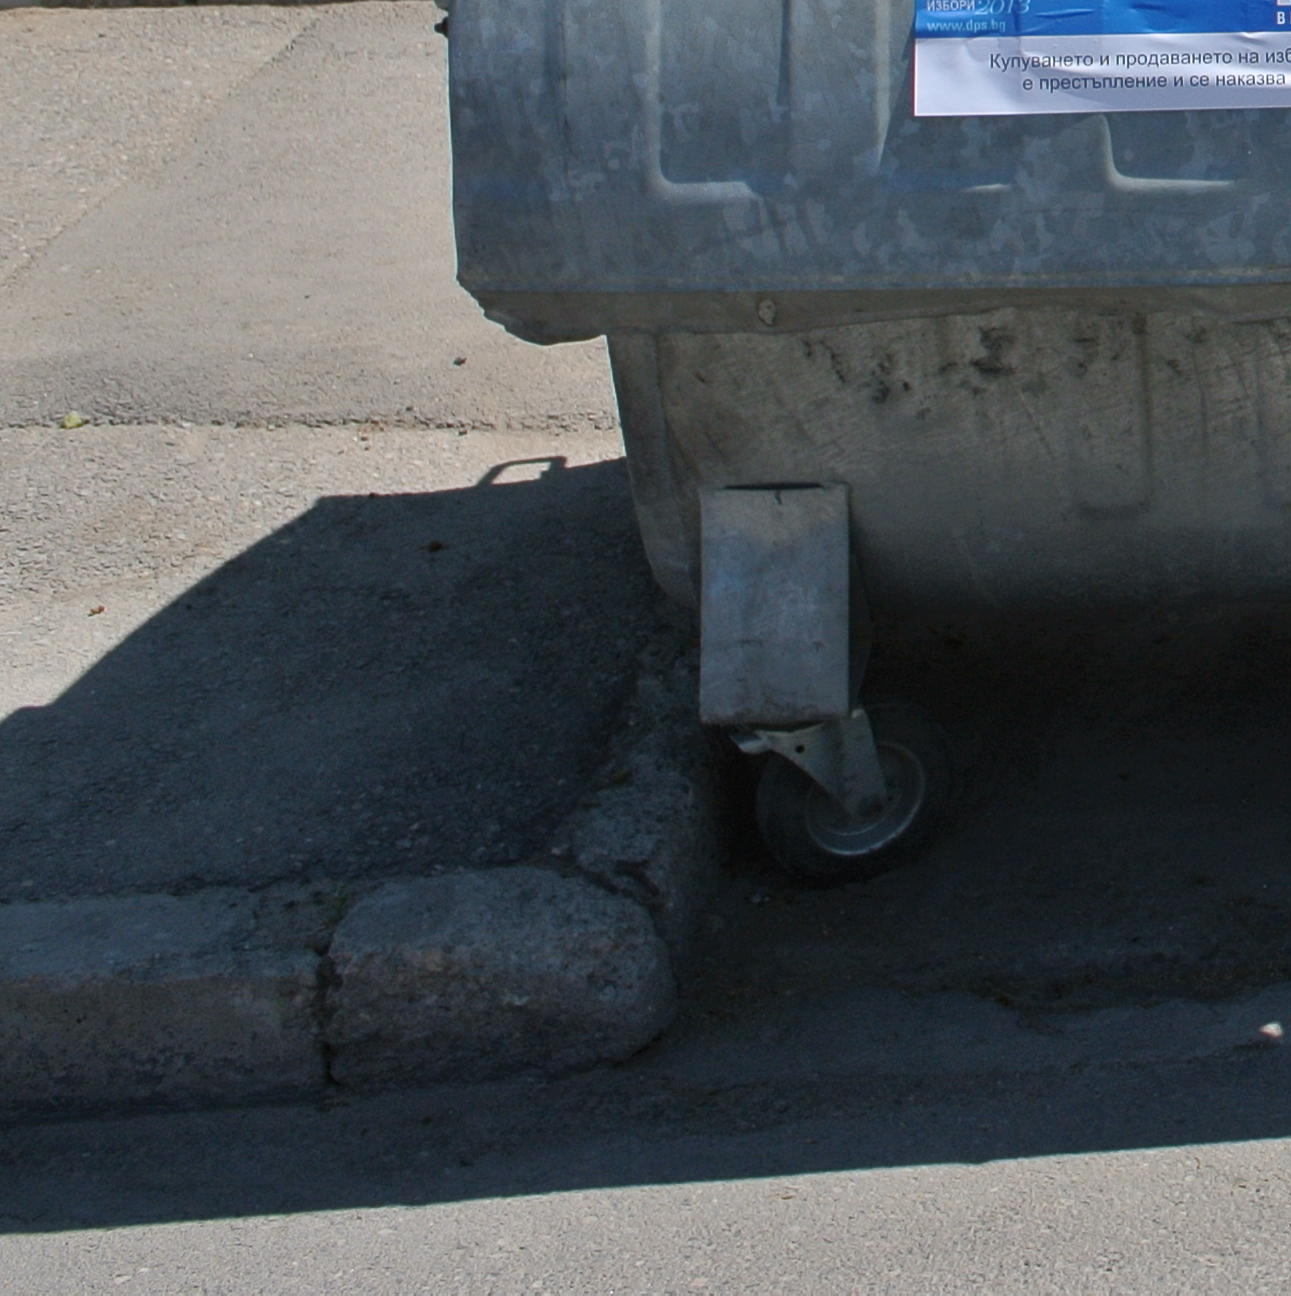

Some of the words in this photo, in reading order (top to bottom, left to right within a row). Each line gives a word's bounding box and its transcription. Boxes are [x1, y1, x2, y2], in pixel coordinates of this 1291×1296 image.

[927, 0, 975, 12] ИЗБОРИ
[1277, 11, 1287, 25] В
[990, 51, 1094, 71] Купуването
[1100, 54, 1110, 65] и
[1116, 51, 1232, 68] продаването
[1238, 53, 1260, 65] на
[1023, 80, 1033, 91] е
[1039, 75, 1168, 93] престъпление
[1173, 76, 1183, 87] и
[1190, 76, 1210, 87] се
[1216, 74, 1287, 86] наказва
